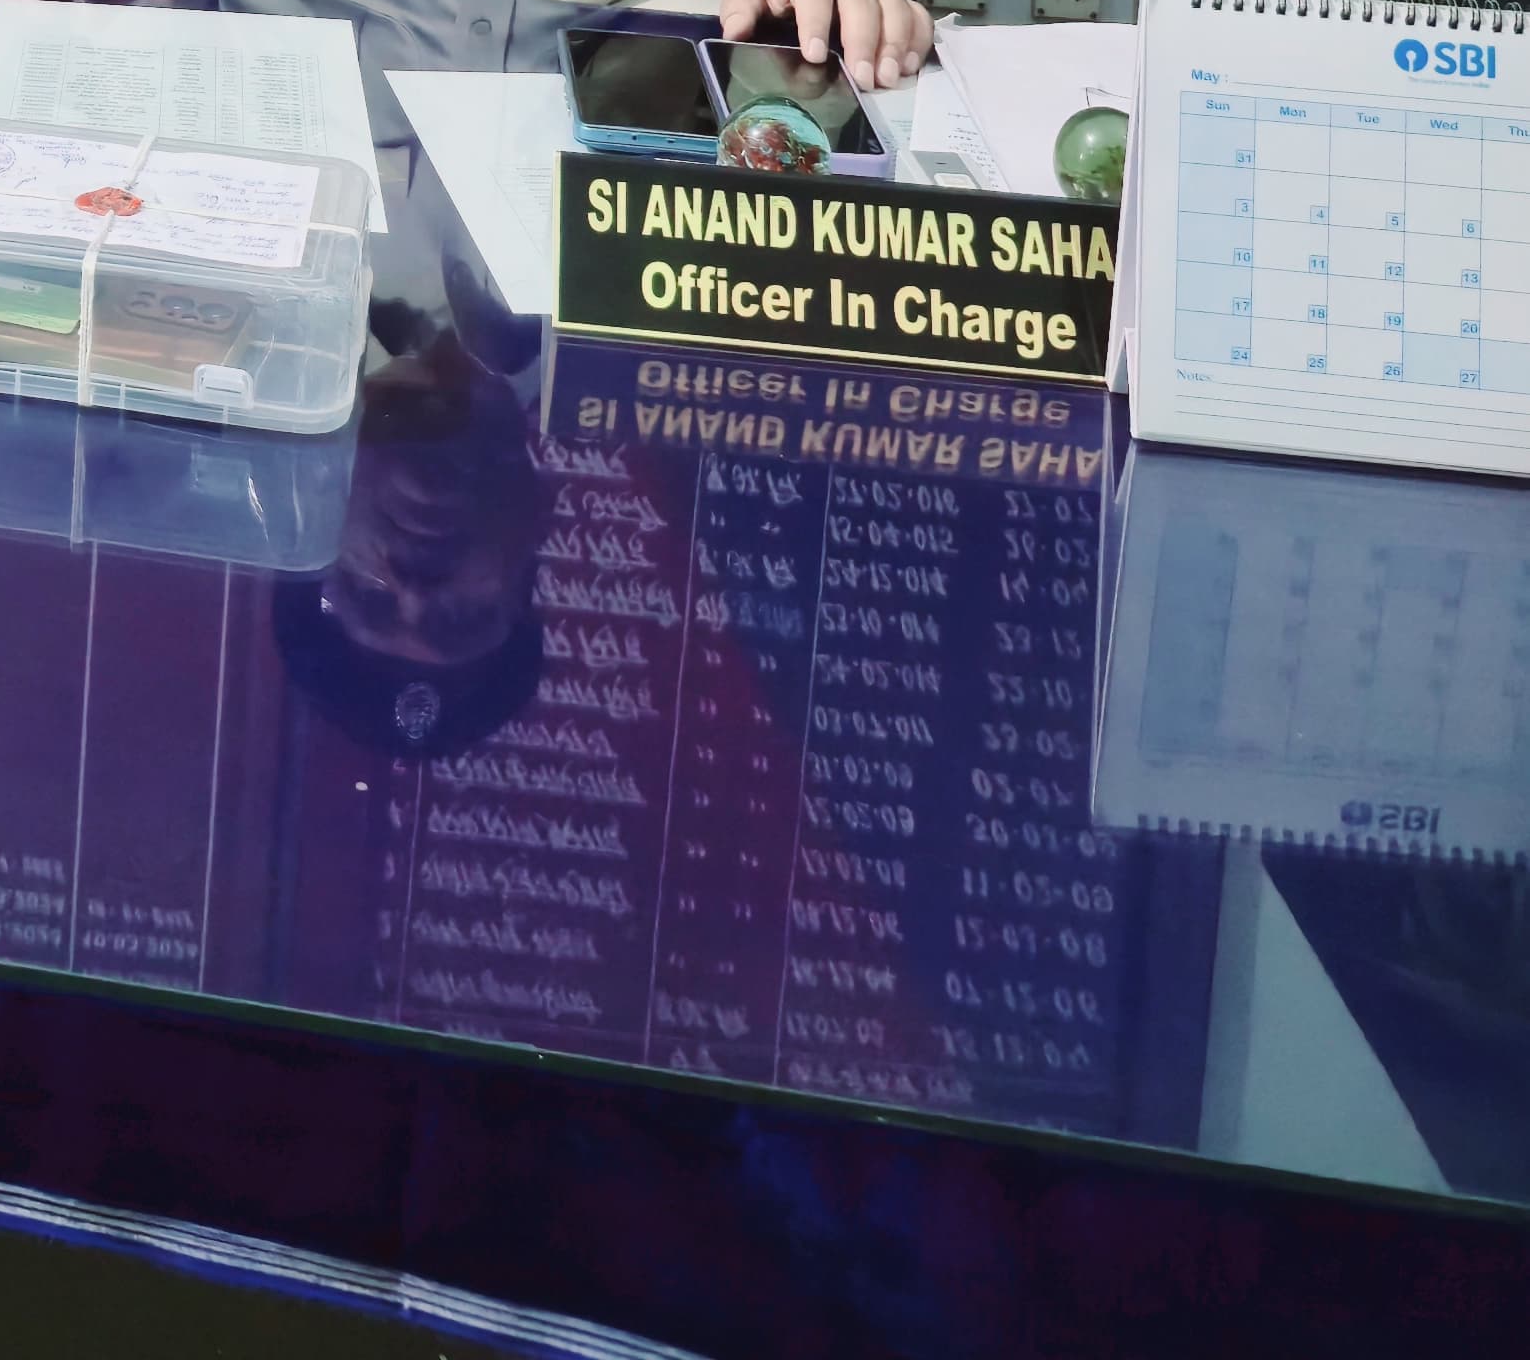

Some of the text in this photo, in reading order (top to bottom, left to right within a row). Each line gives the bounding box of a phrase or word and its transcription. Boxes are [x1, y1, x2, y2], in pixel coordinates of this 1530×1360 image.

[1434, 41, 1496, 79] SBI
[1206, 100, 1230, 112] Sun
[1279, 106, 1307, 118] Mon
[1356, 112, 1380, 125] Tue
[1429, 119, 1459, 131] Wed
[587, 178, 1116, 281] SI ANAND KUMAR SAHA
[1236, 251, 1479, 284] 10 11 12 13
[640, 261, 1078, 360] Officer In Charge
[1234, 301, 1478, 334] 17 18 19 20
[1233, 350, 1478, 384] 24 25 26 27
